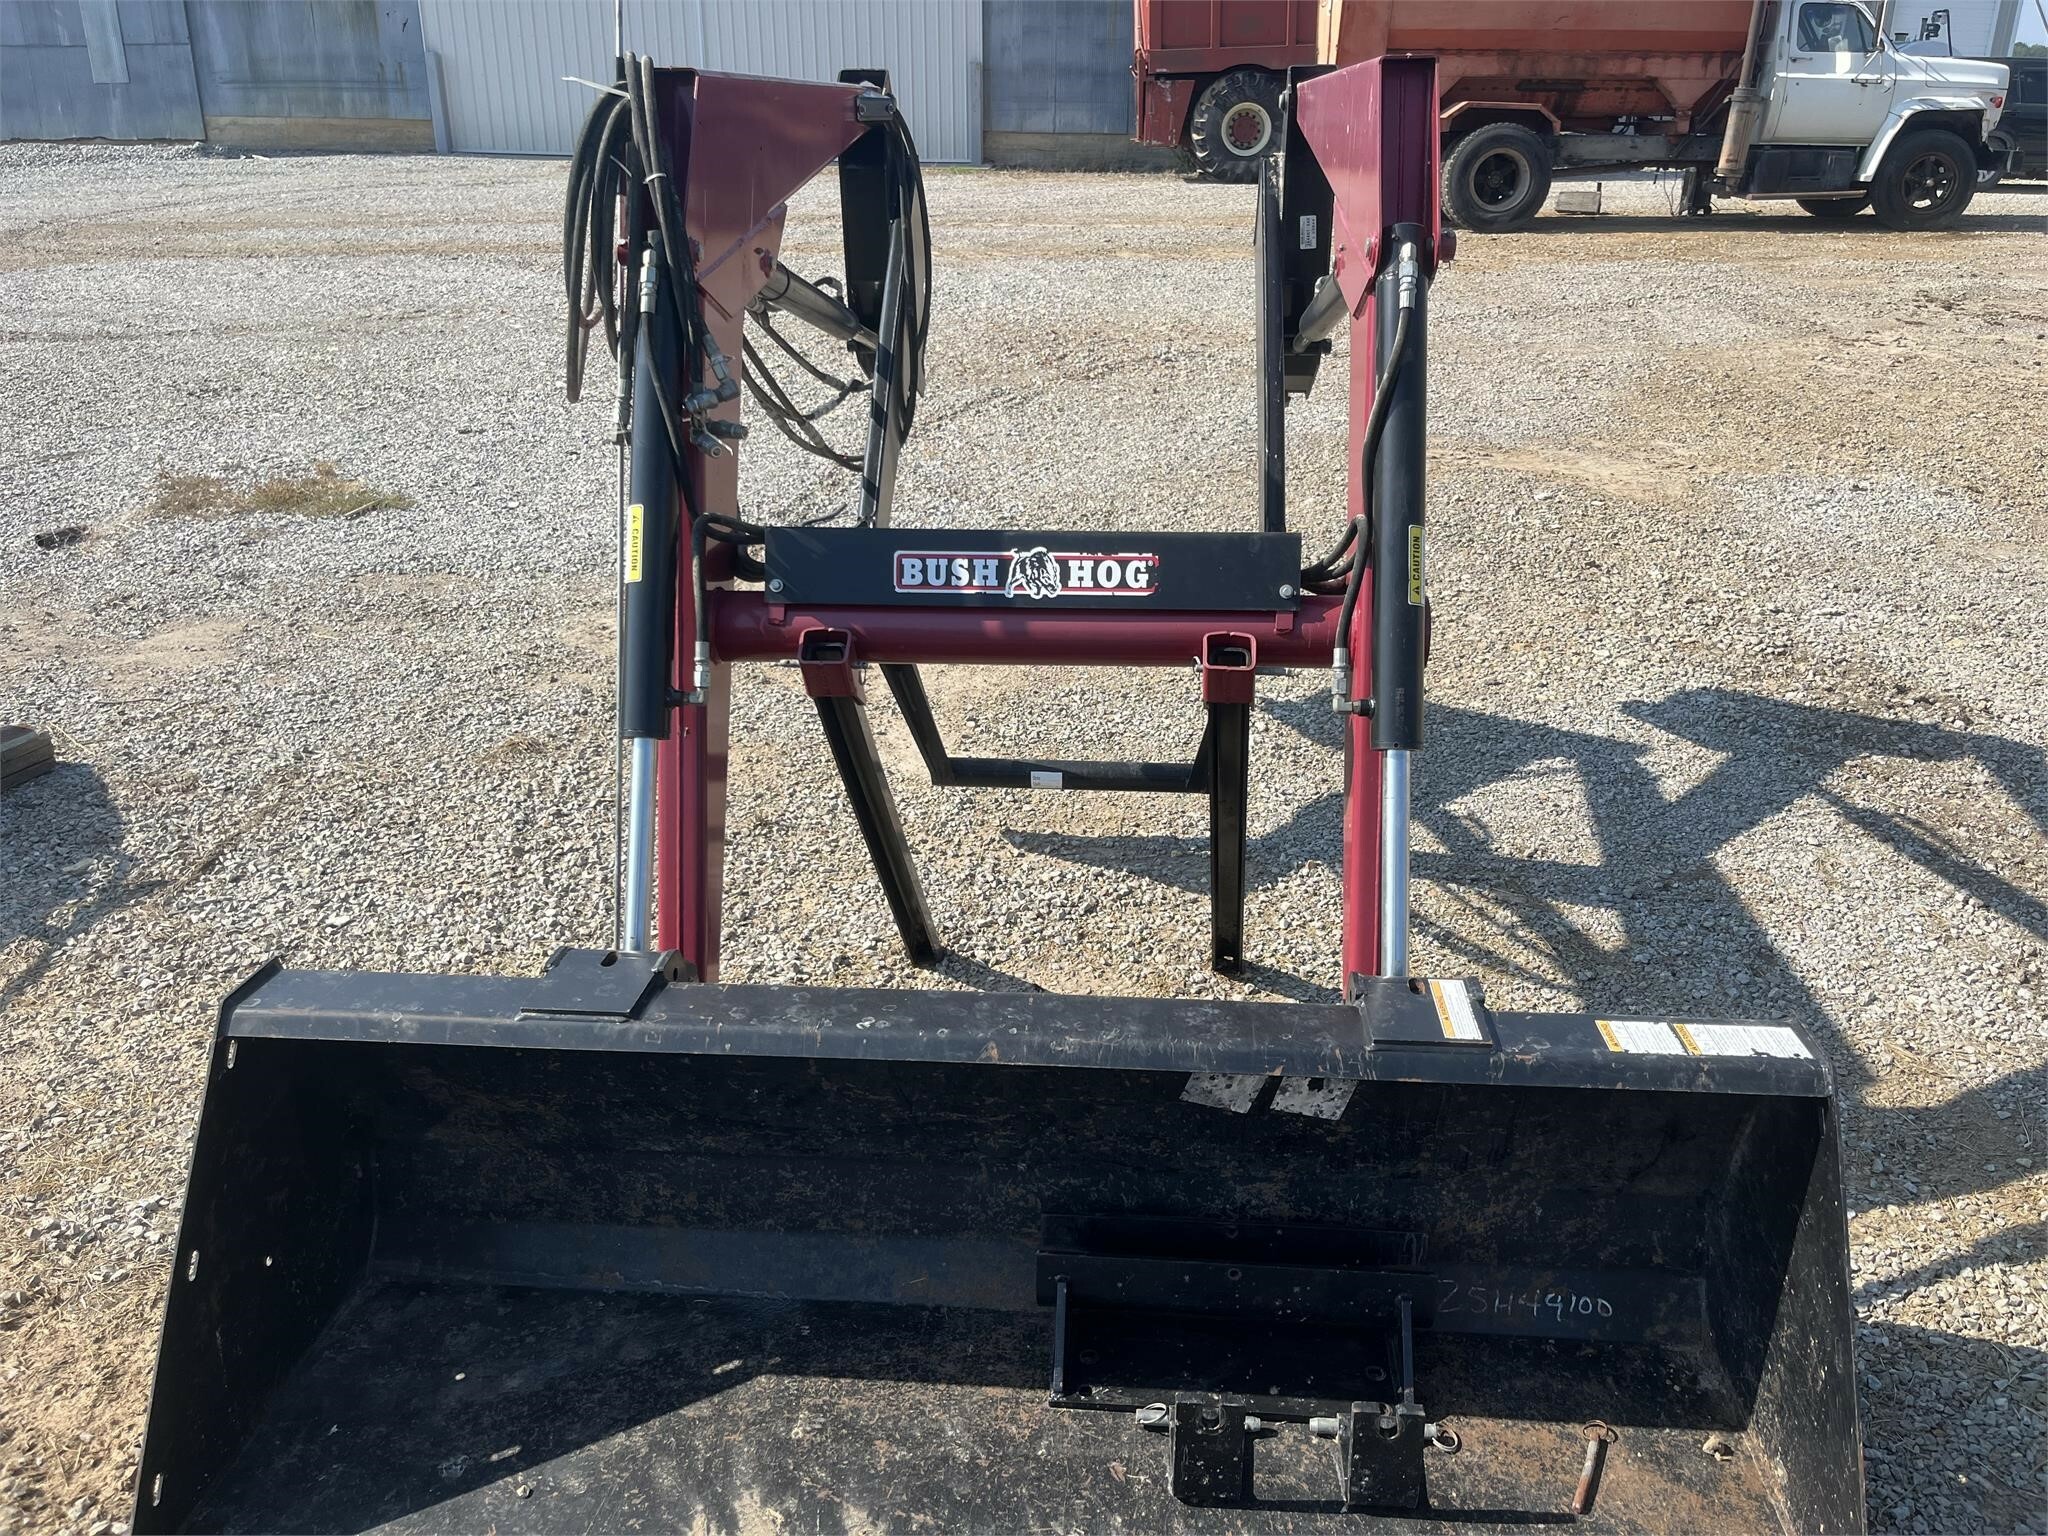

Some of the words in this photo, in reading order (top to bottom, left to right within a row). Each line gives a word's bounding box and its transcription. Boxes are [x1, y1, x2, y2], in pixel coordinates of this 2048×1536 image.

[631, 528, 640, 571] CAUTION
[1412, 536, 1420, 581] CAUTION
[901, 558, 999, 587] BUSH
[1067, 559, 1149, 588] HOG
